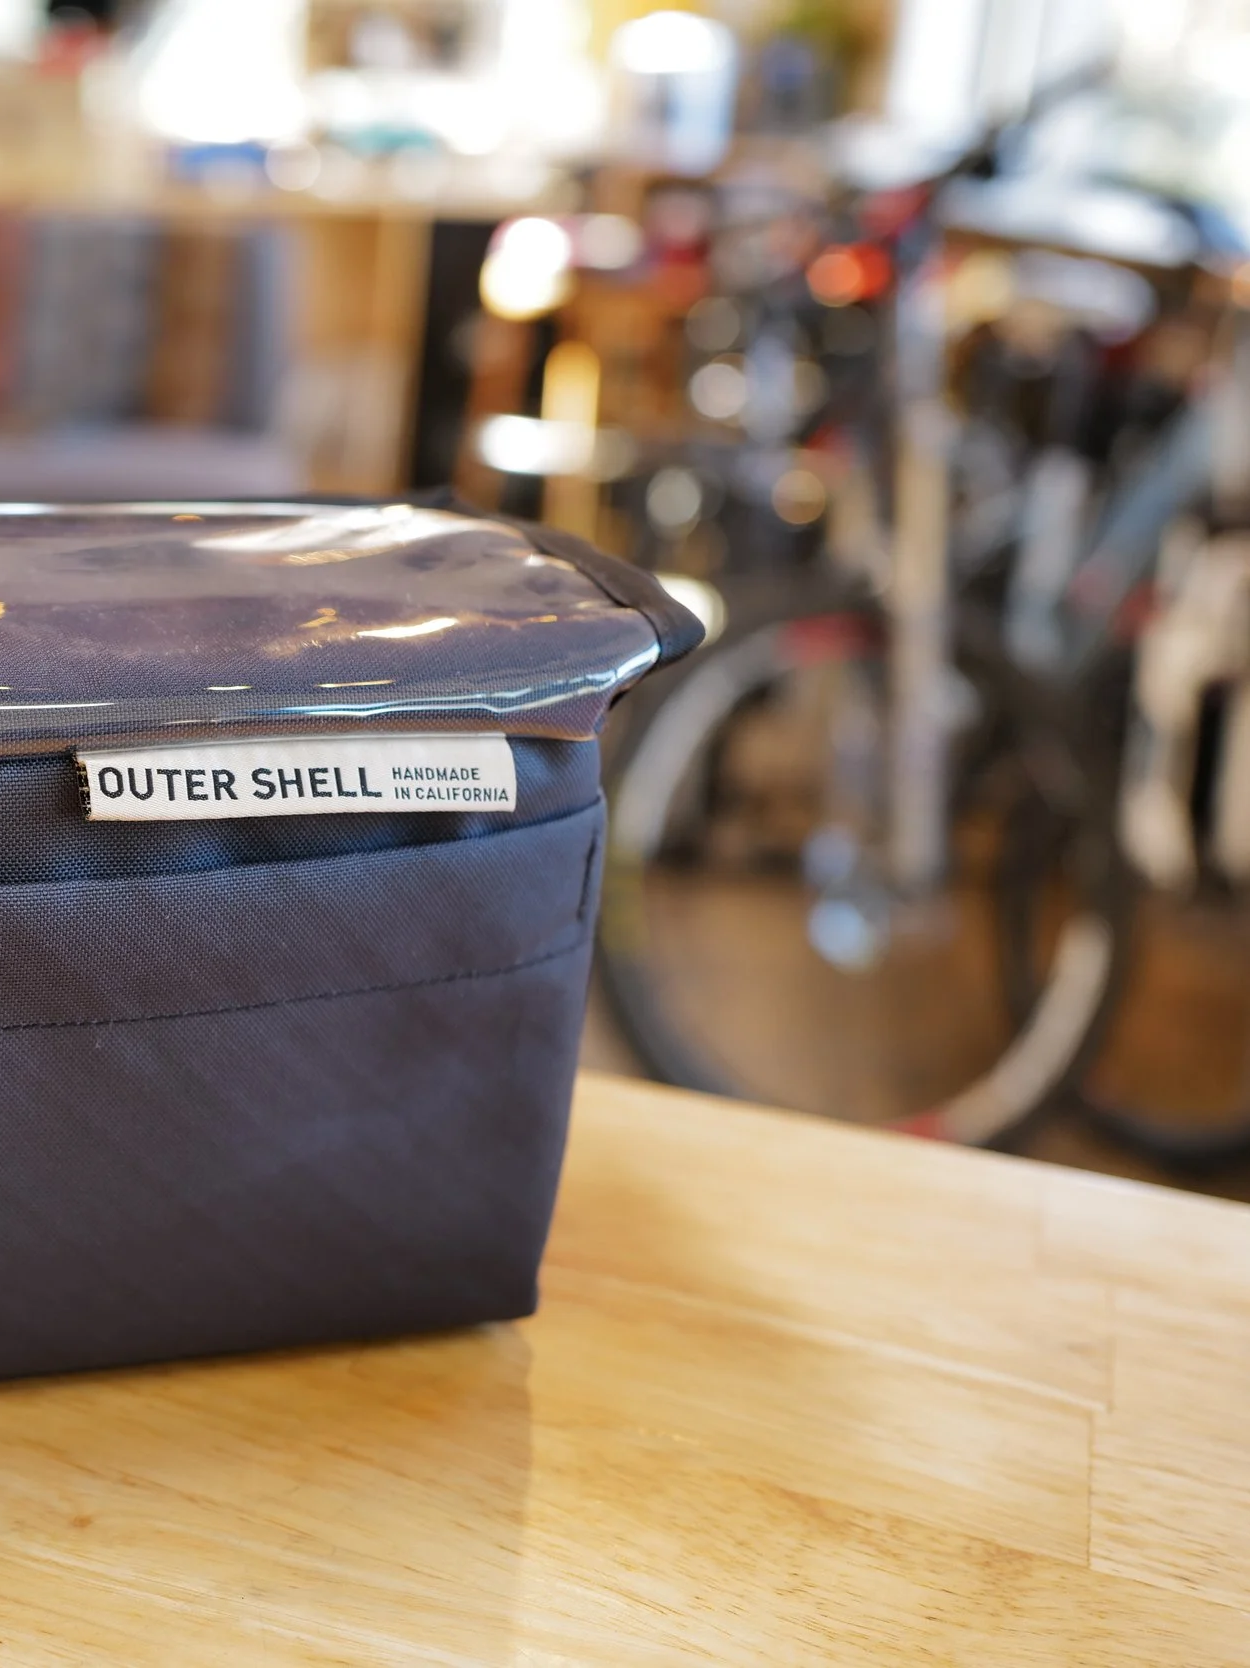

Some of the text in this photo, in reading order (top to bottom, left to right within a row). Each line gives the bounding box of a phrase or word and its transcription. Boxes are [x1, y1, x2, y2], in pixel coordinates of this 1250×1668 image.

[392, 767, 481, 782] HANDMADE
[97, 766, 383, 801] OUTER SHELL
[394, 786, 509, 802] IN CALIFORNIA
